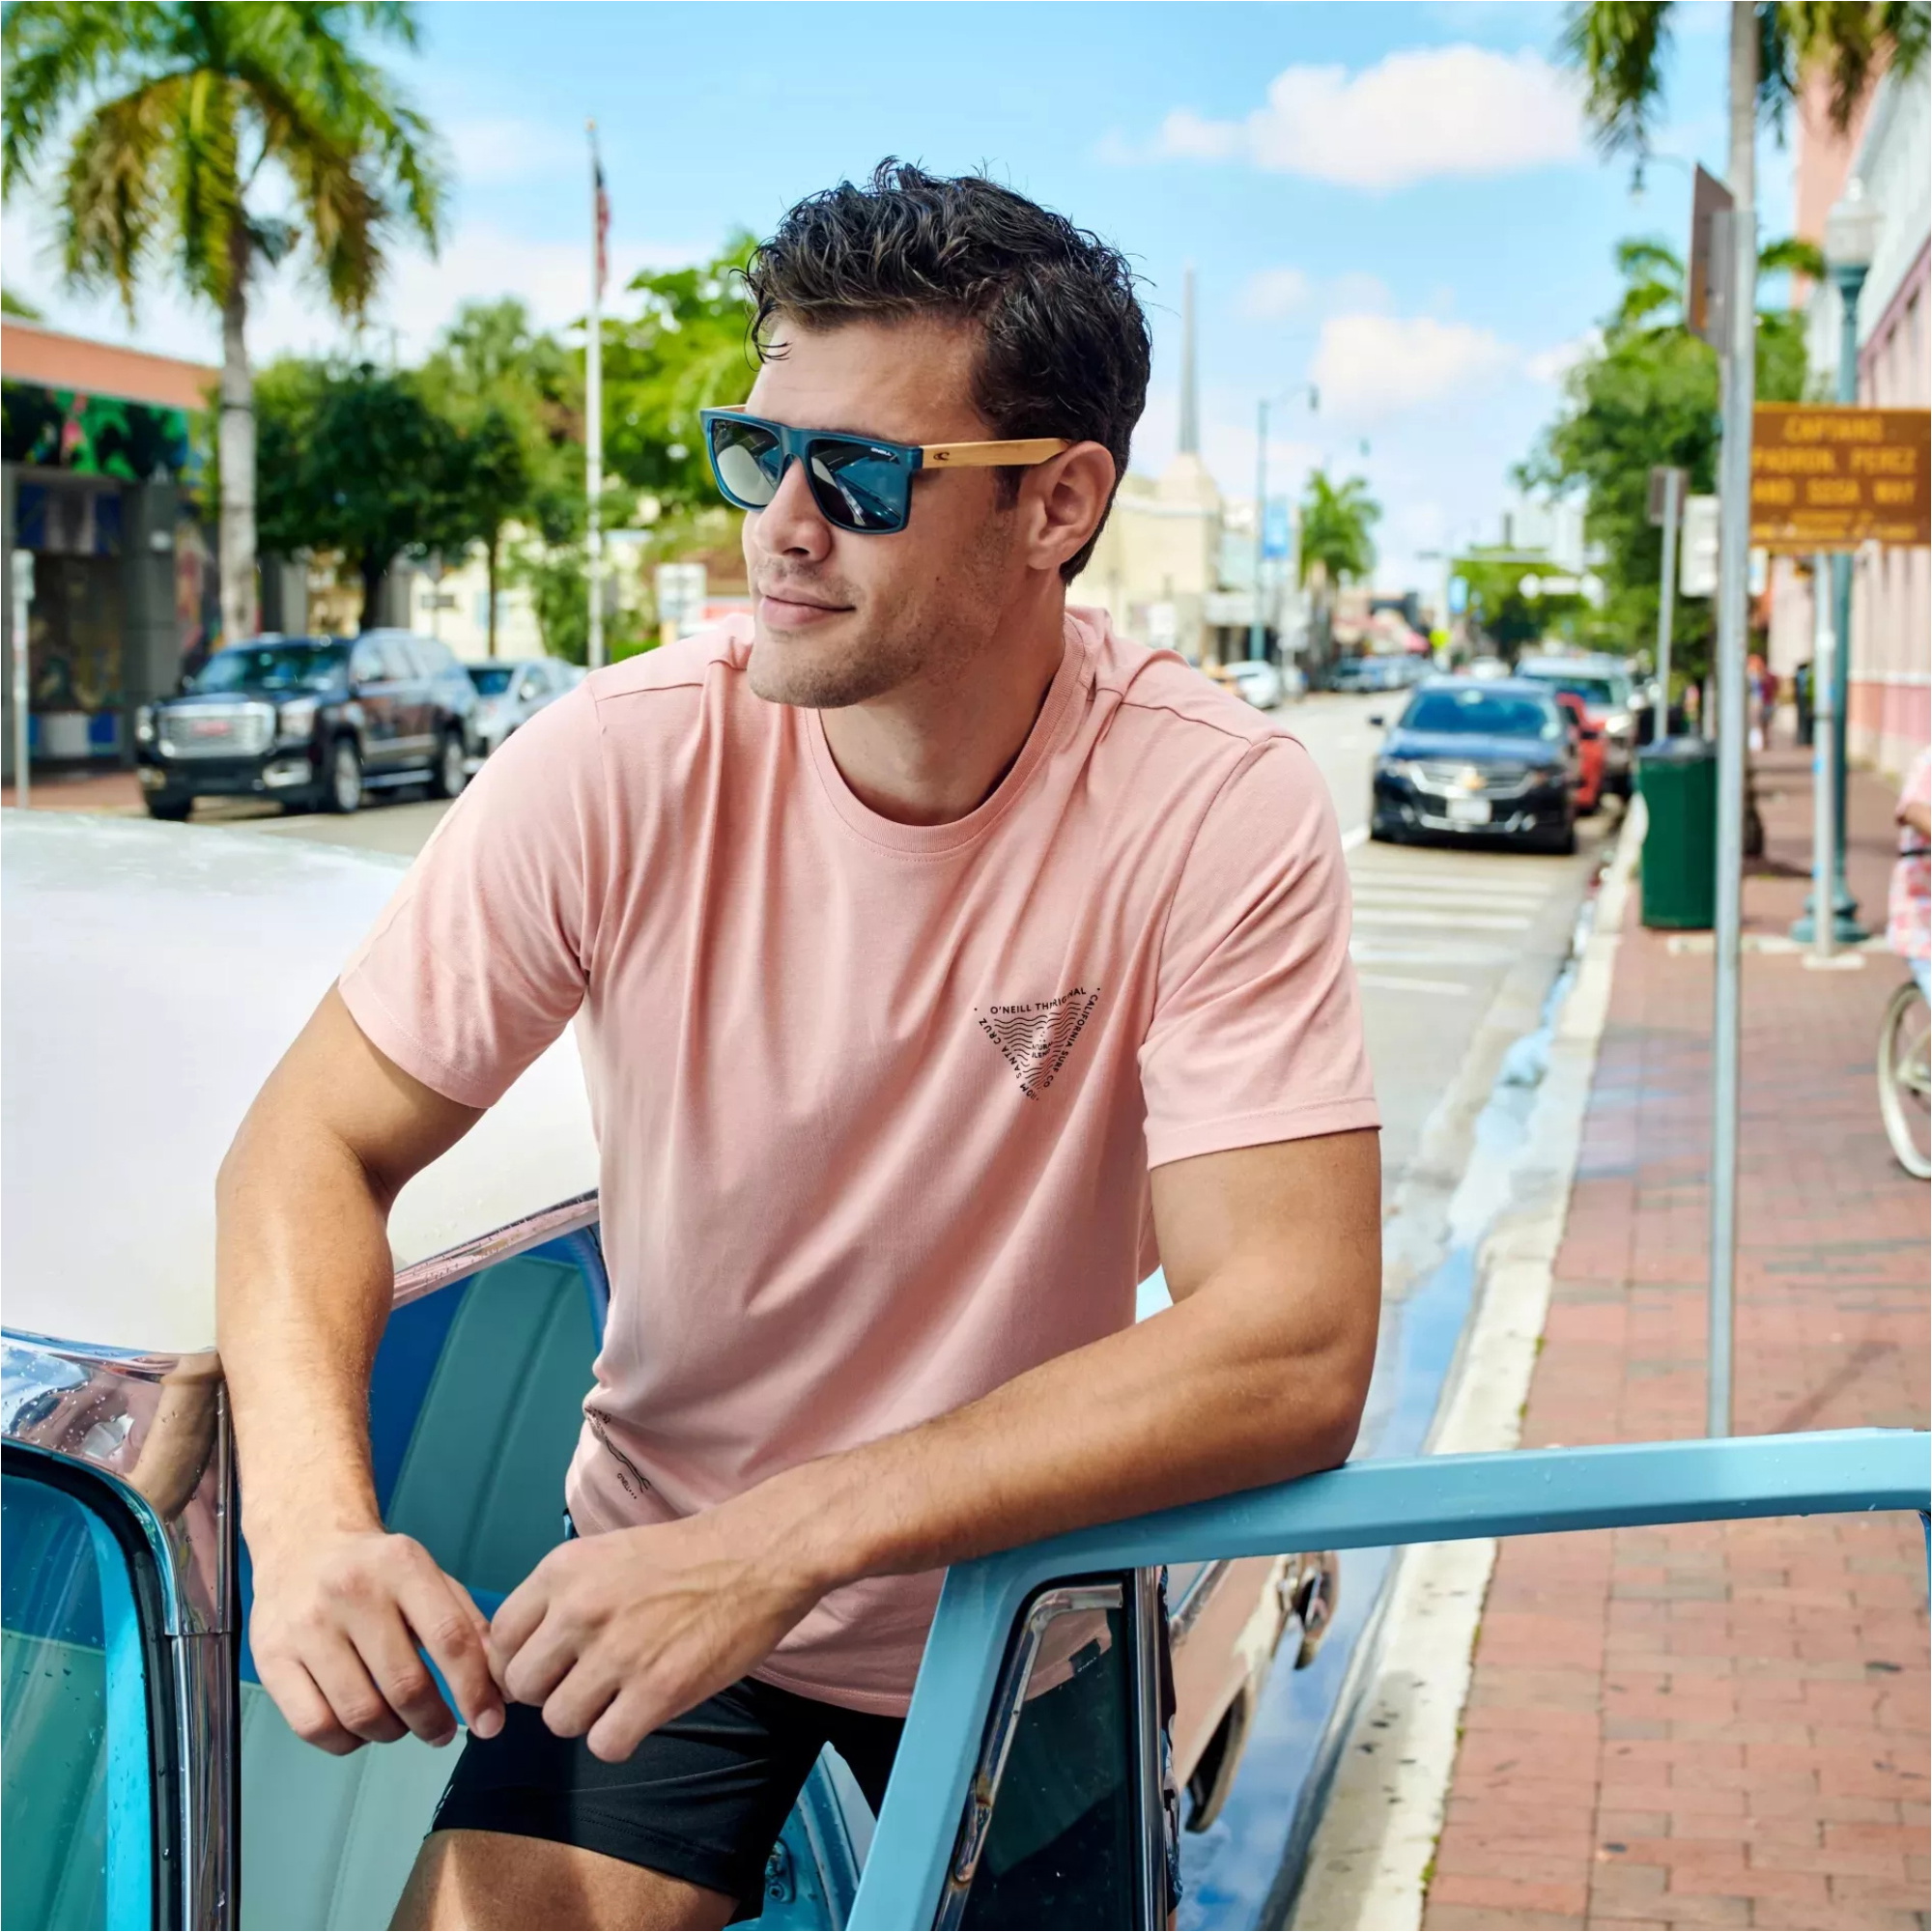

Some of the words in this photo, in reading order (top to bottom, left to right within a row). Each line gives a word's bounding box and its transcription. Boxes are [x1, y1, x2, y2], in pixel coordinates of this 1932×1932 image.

[990, 1005, 1032, 1014] O'NEILL
[1065, 994, 1098, 1047] CALIFORNIA
[979, 1017, 1001, 1044] CRUZ
[1001, 1046, 1022, 1079] SANTA
[1052, 1050, 1068, 1072] SURF
